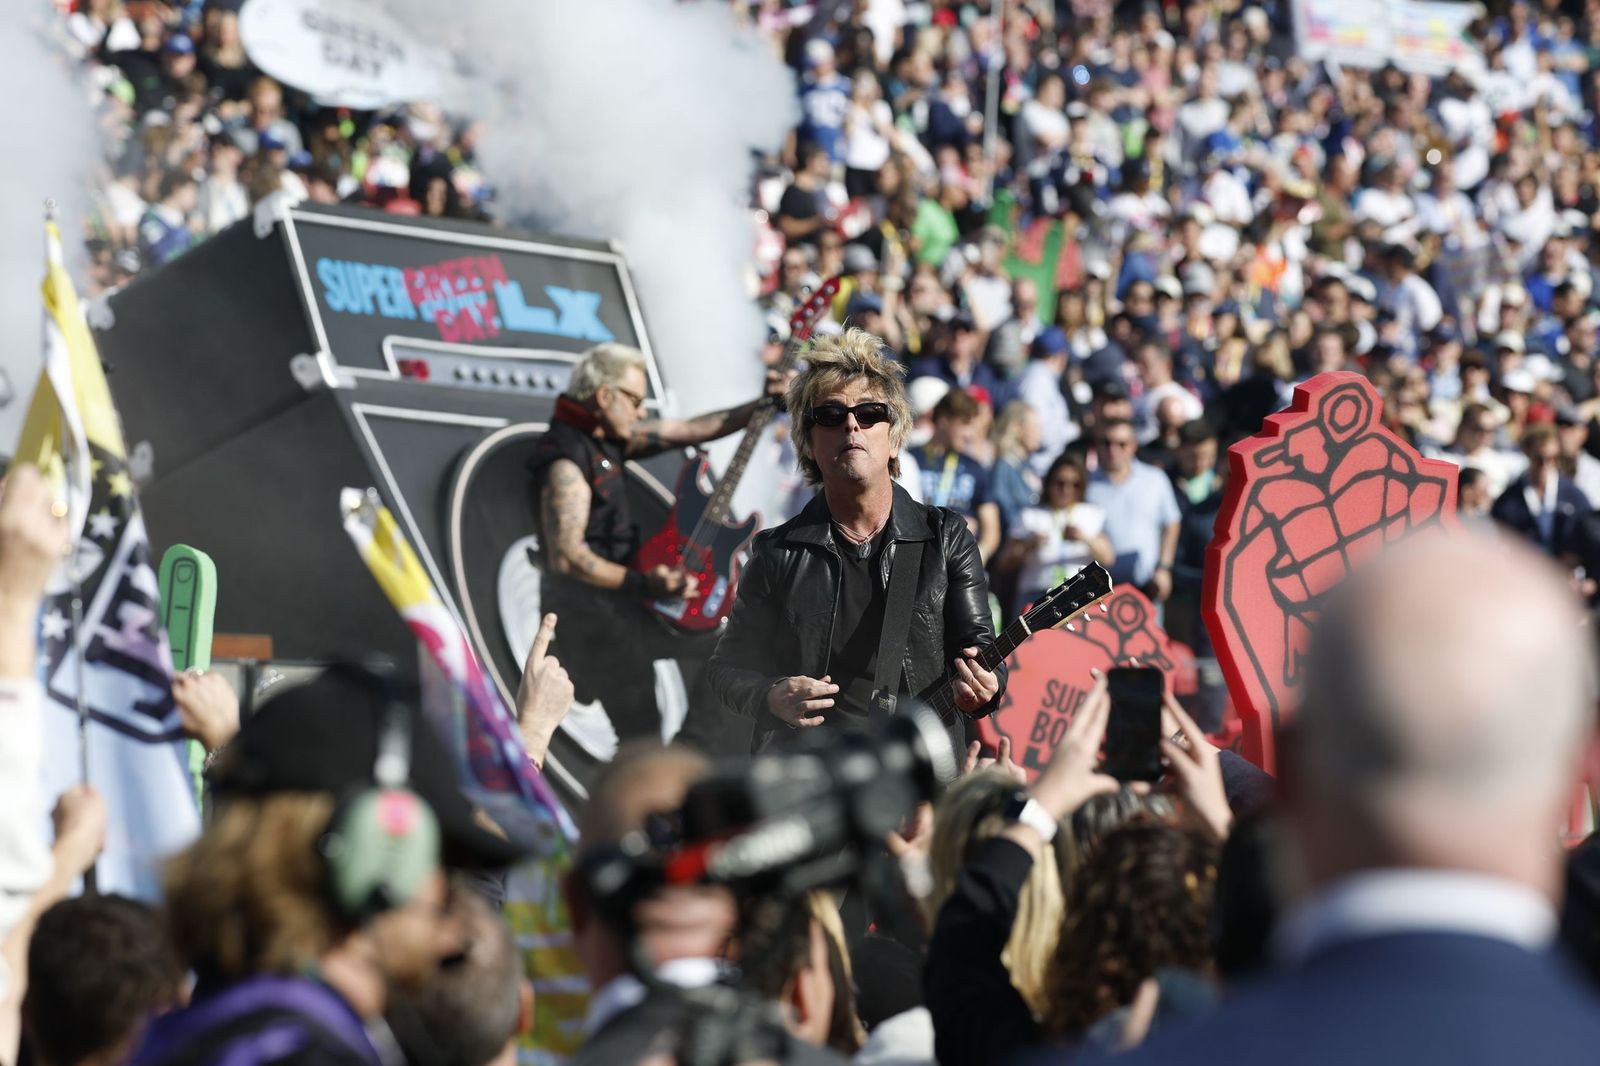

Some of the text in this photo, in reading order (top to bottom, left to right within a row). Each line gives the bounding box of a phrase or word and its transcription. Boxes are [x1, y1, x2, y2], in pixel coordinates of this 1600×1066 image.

[321, 40, 382, 79] DAY
[316, 257, 416, 320] SUPER
[494, 279, 615, 342] LX
[1042, 679, 1087, 717] SUP
[1031, 711, 1067, 749] BO
